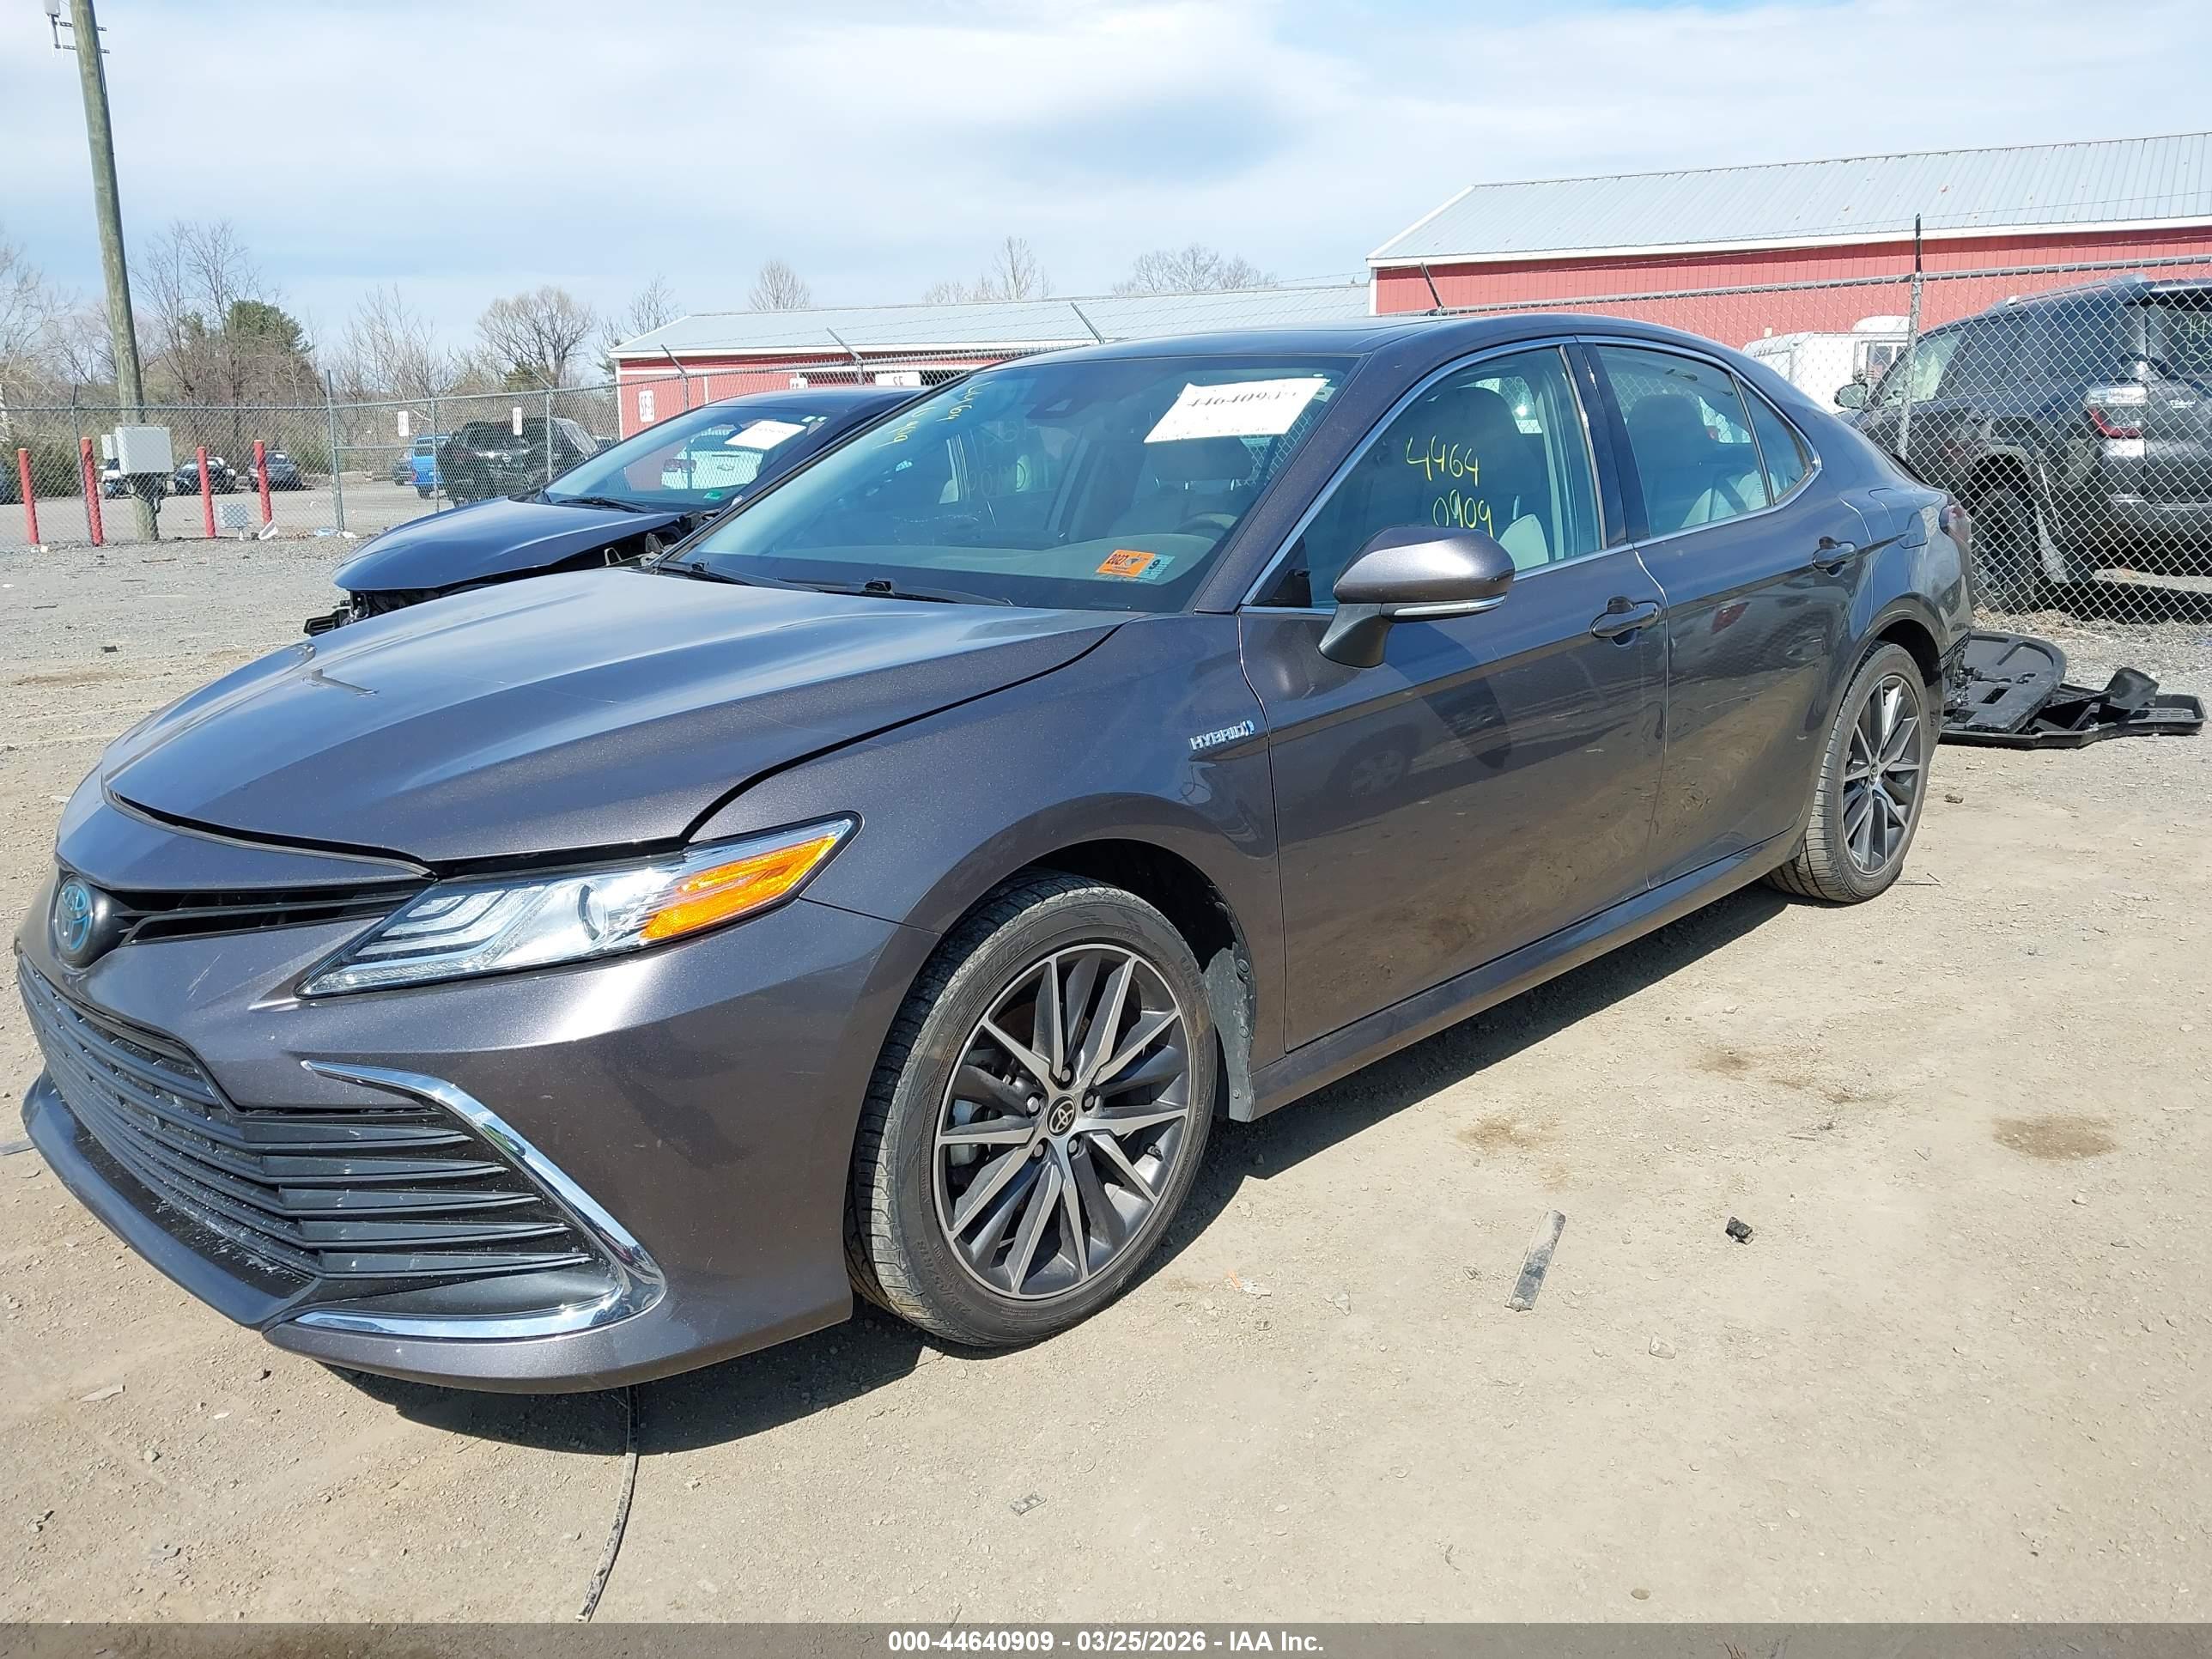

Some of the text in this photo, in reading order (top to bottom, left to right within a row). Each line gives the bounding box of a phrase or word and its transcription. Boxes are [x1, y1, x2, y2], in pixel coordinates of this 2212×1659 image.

[1186, 390, 1297, 407] 446409
[1406, 434, 1479, 488] 4464
[1432, 489, 1494, 538] 0909
[1105, 554, 1129, 566] 2027
[1188, 721, 1249, 750] HYBRID
